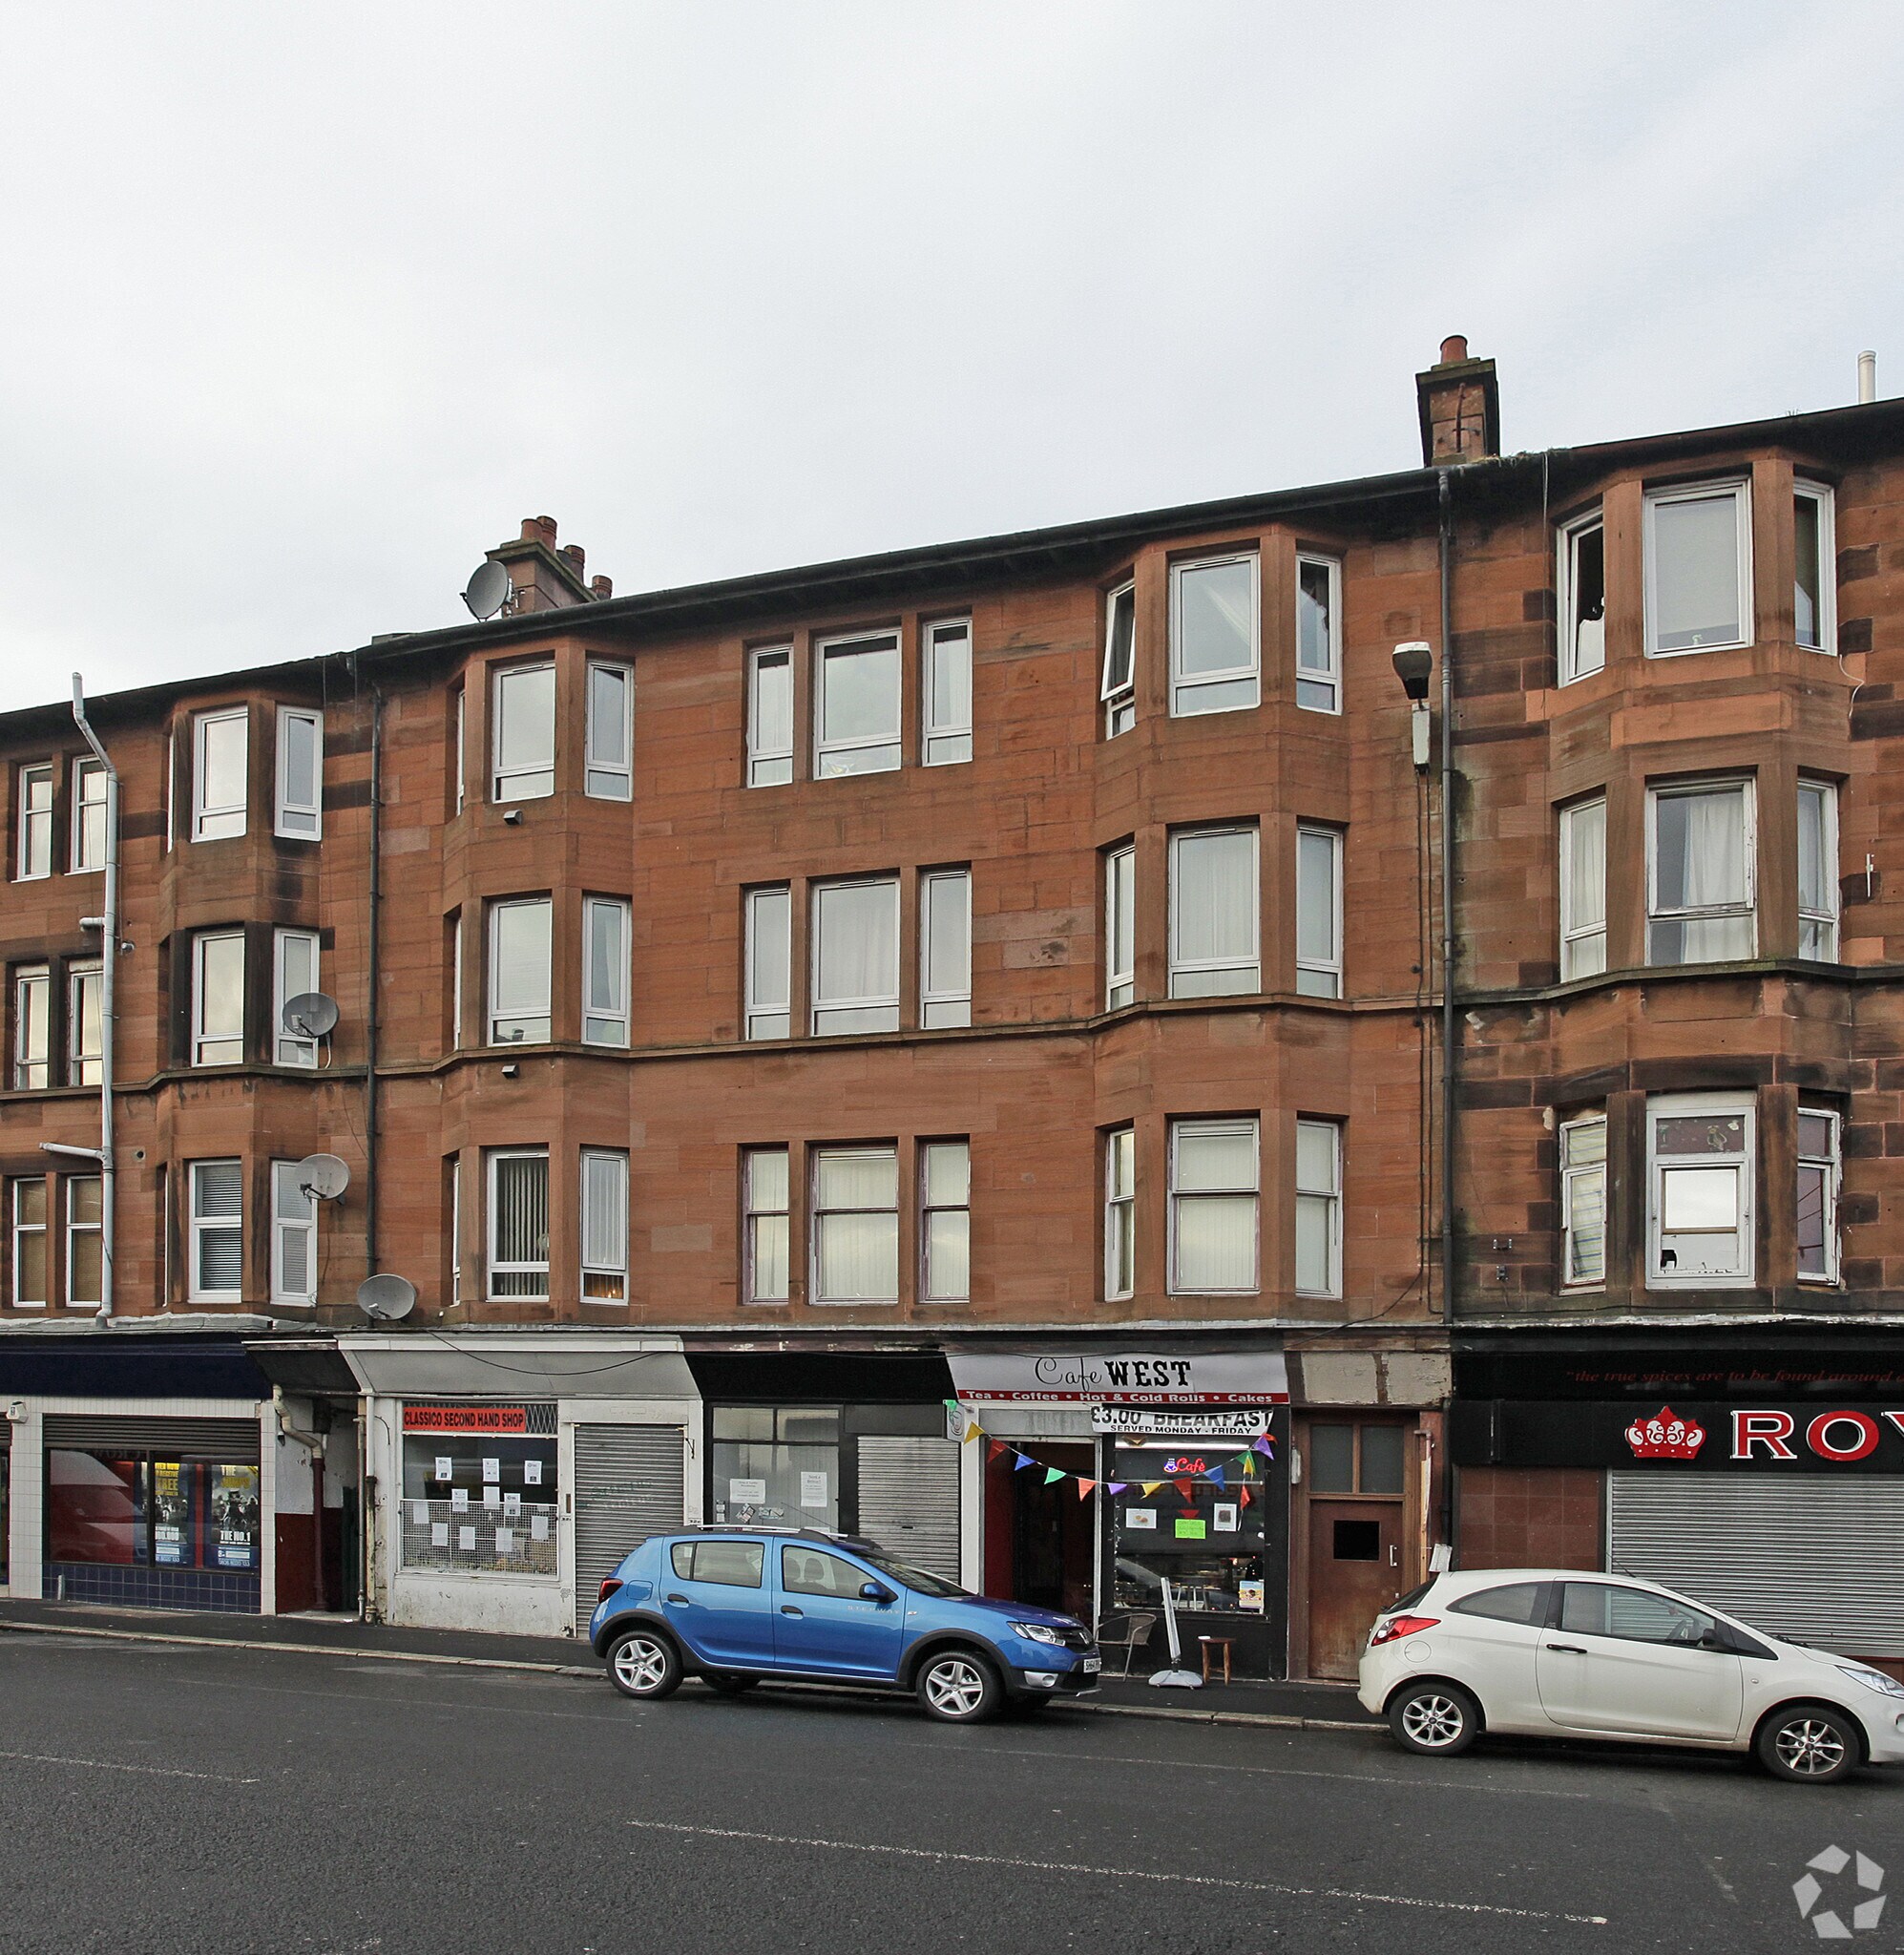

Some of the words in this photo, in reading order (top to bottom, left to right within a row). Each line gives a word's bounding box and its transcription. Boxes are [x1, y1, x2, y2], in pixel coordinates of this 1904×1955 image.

[1035, 1356, 1102, 1392] Cafe
[1104, 1360, 1191, 1387] WEST
[1604, 1372, 1637, 1381] true
[1642, 1370, 1691, 1382] spices
[1695, 1372, 1725, 1381] are
[1728, 1370, 1745, 1381] to
[1749, 1369, 1769, 1381] be
[1771, 1369, 1826, 1383] found
[1828, 1370, 1894, 1382] around
[966, 1390, 993, 1399] Tea
[1012, 1391, 1059, 1401] Coffee
[1079, 1392, 1107, 1401] Hot
[1112, 1393, 1123, 1401] &
[1129, 1393, 1163, 1402] Cold
[1169, 1394, 1206, 1402] Rolls
[1227, 1394, 1272, 1403] Cakes
[404, 1411, 443, 1426] CLASSICO
[444, 1412, 476, 1427] SECOND
[477, 1413, 500, 1427] HAND
[501, 1413, 524, 1428] SHOP
[1090, 1405, 1142, 1425] £3.00
[1153, 1409, 1274, 1428] BREAKFAST
[1110, 1424, 1153, 1433] SERVED
[1154, 1426, 1202, 1435] MONDAY
[220, 1464, 237, 1477] THE
[220, 1530, 233, 1541] THE
[847, 1606, 900, 1614] STEPWAY
